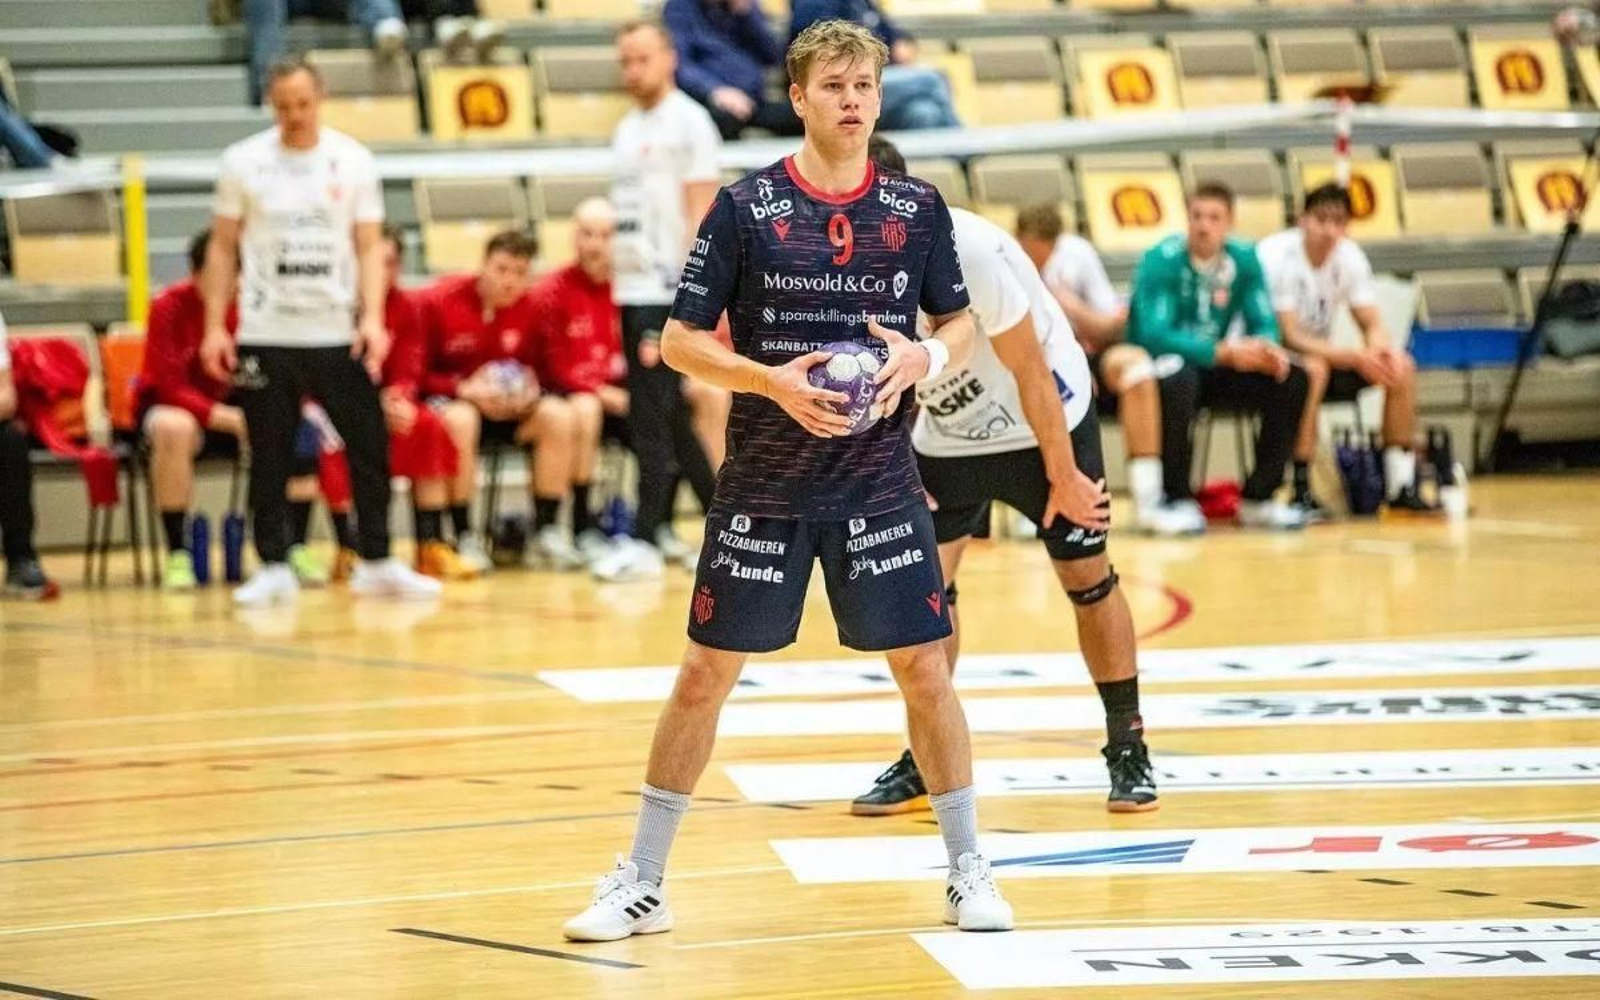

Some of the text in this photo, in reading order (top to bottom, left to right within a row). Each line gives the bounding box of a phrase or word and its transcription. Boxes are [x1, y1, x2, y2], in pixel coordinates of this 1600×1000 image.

[750, 199, 792, 220] bico
[879, 188, 918, 213] bico
[829, 213, 853, 266] 9
[764, 272, 886, 293] Mosvold&Co
[717, 530, 786, 556] PIZZABAKEREN
[846, 522, 914, 553] PIZZABAKEREN
[730, 561, 784, 583] Lunde
[870, 548, 924, 576] Lunde
